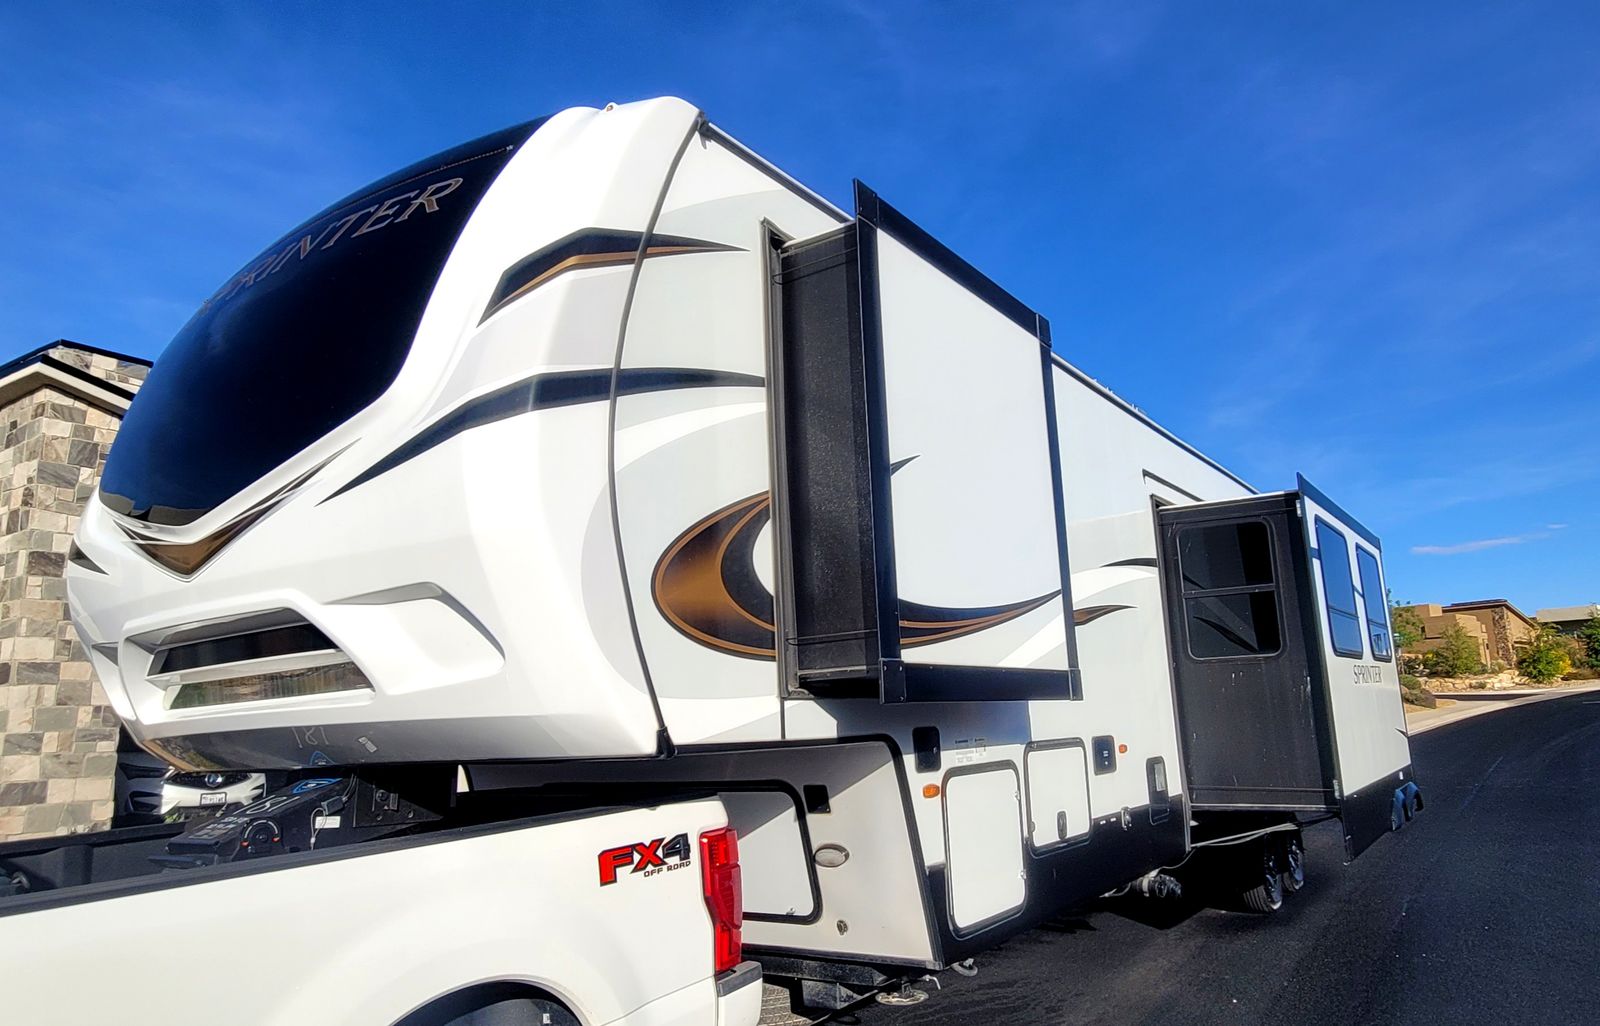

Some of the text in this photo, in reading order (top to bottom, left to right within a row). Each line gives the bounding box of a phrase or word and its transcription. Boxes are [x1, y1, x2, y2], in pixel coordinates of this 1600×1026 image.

[205, 177, 463, 303] RINTER
[1353, 665, 1382, 684] SPRINTER
[598, 832, 691, 887] FX4
[644, 860, 691, 877] OFF ROAD
